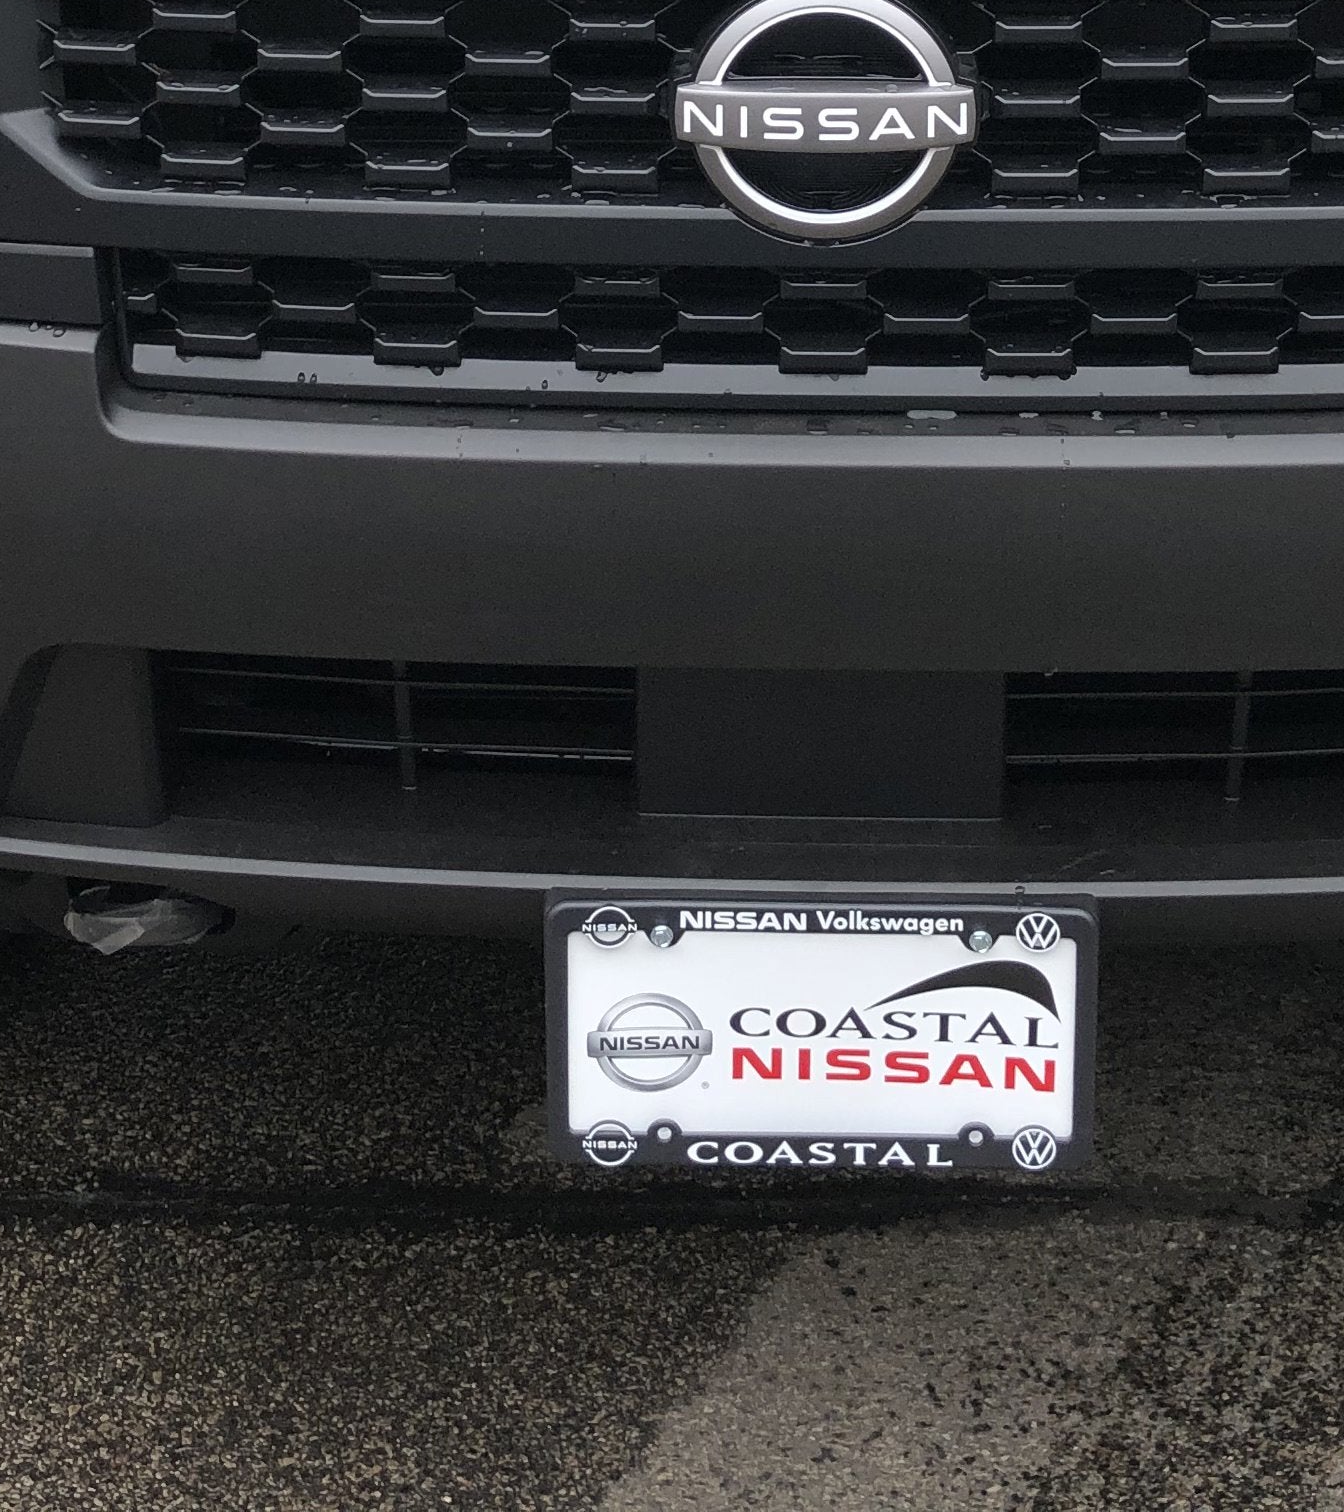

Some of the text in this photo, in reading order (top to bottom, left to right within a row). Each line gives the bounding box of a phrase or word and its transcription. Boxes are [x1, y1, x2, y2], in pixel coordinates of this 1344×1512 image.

[683, 101, 968, 141] NISSAN
[581, 922, 638, 934] NISSAN
[679, 910, 964, 935] NISSAN Volkswagen
[729, 1006, 1059, 1048] COASTAL
[599, 1035, 701, 1051] NISSAN
[732, 1047, 1056, 1093] NISSAN
[581, 1139, 638, 1150] NISSAN
[687, 1141, 953, 1167] COASTAL
